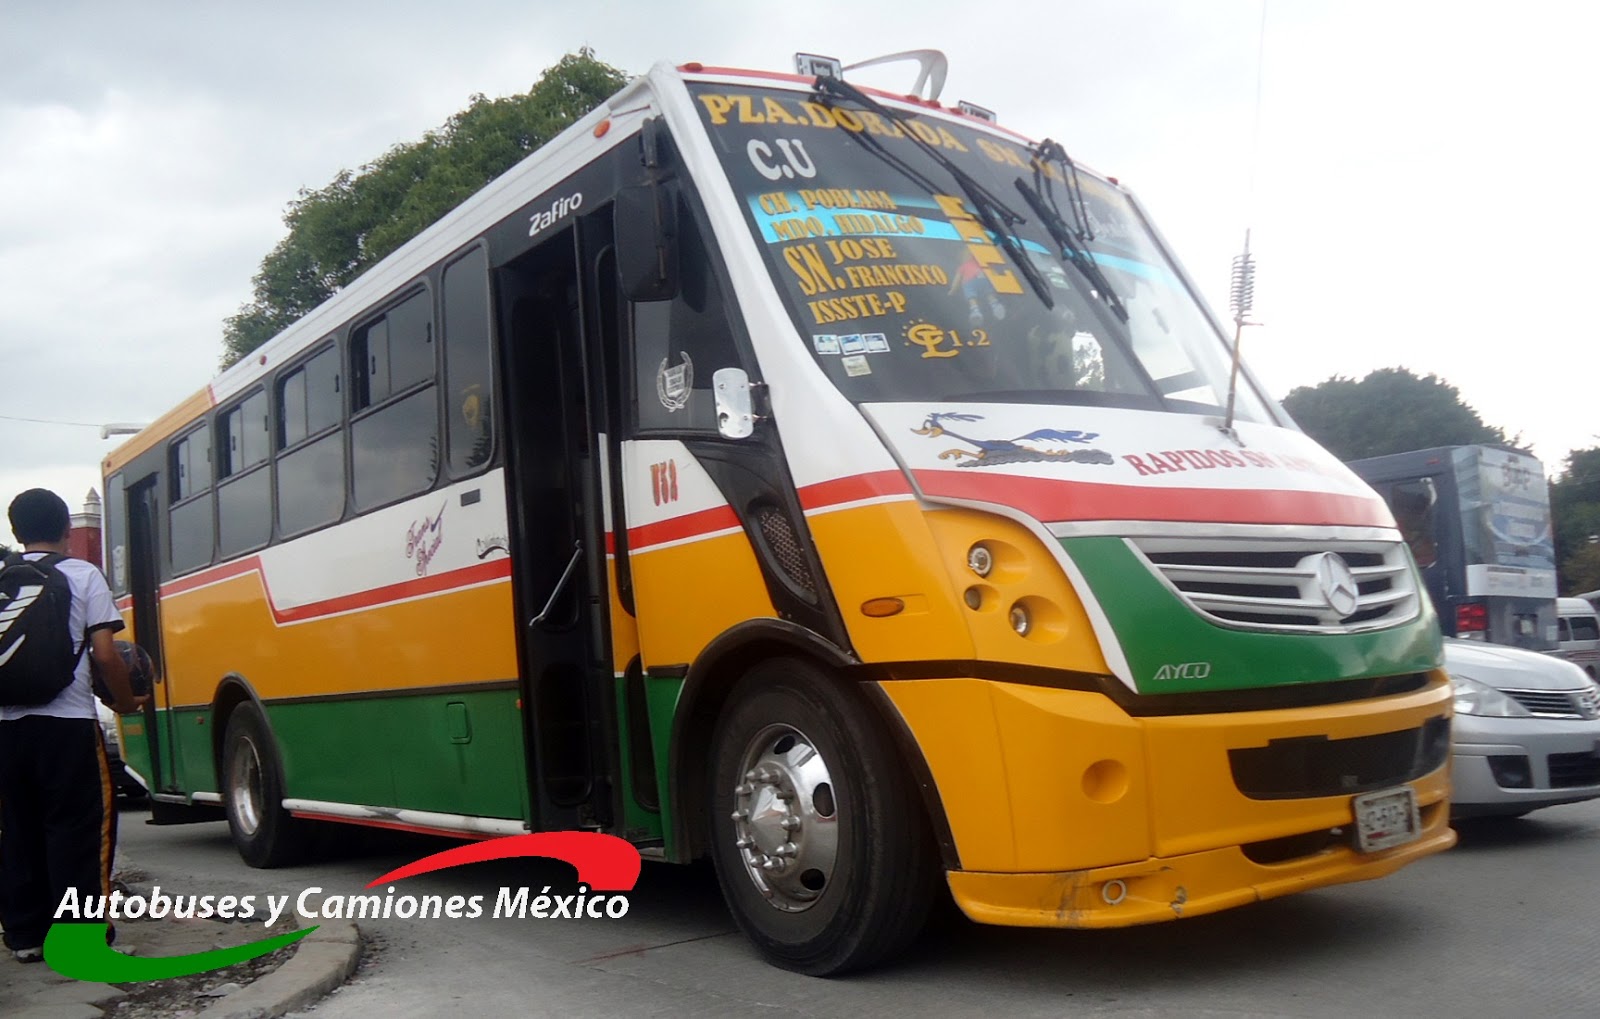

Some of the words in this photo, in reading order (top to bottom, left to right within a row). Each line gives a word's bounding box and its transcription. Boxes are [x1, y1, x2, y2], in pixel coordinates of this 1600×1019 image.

[746, 138, 817, 181] C.U
[798, 188, 898, 211] POBLANA
[528, 192, 583, 237] Zafiro
[832, 213, 926, 235] HIDALGO
[782, 243, 847, 296] SN.
[825, 238, 897, 265] JOSE
[844, 264, 949, 289] FRANCISCO
[807, 291, 908, 325] ISSSTE-P
[1121, 449, 1247, 477] RAPIDOS
[1152, 661, 1211, 680] AYCO
